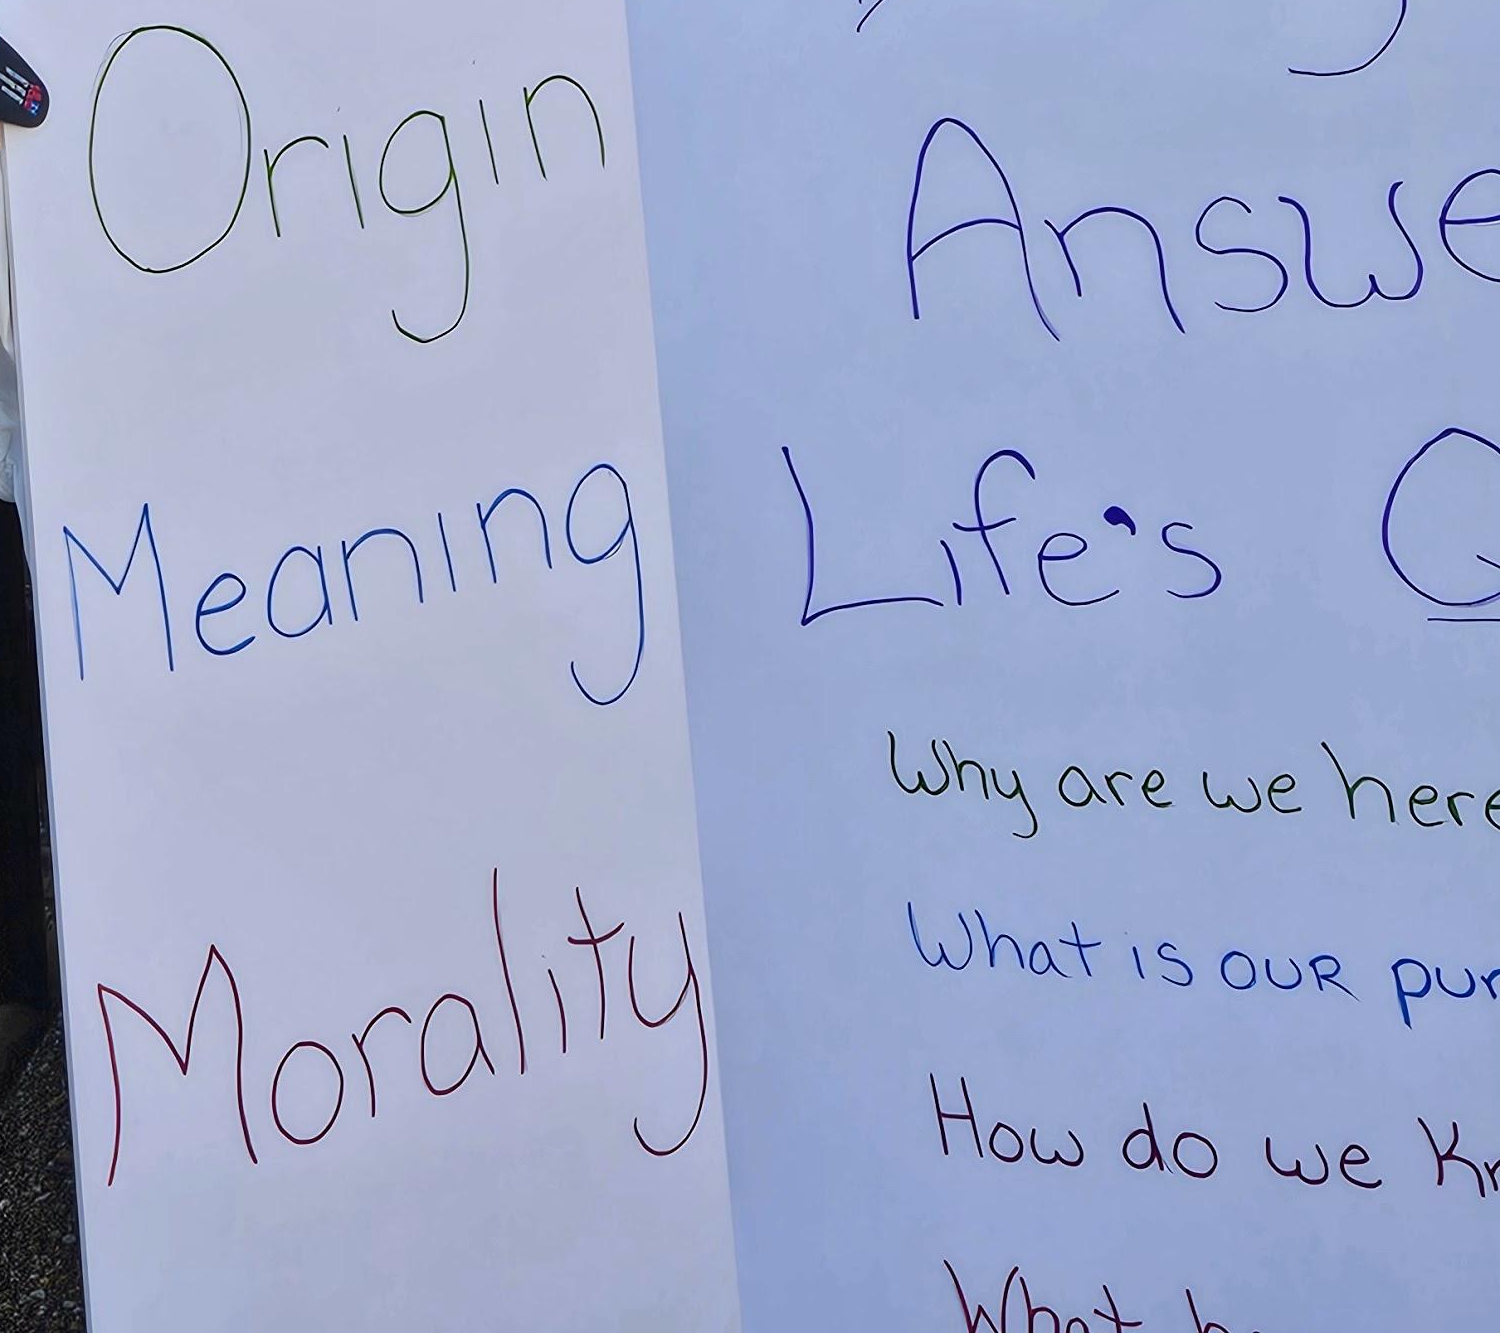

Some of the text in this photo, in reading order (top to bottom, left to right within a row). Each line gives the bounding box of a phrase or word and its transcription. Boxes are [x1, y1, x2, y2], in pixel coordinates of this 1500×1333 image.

[88, 24, 606, 345] Origin
[62, 463, 645, 707] Meaning
[780, 445, 1223, 627] Life's
[886, 730, 1039, 839] Why
[1058, 765, 1173, 808] are
[1202, 770, 1303, 814] we
[96, 867, 709, 1187] Morality
[907, 901, 1102, 979] What
[1131, 941, 1194, 987] is
[929, 1072, 1086, 1168] How
[1121, 1101, 1219, 1179] do
[1265, 1136, 1384, 1190] we
